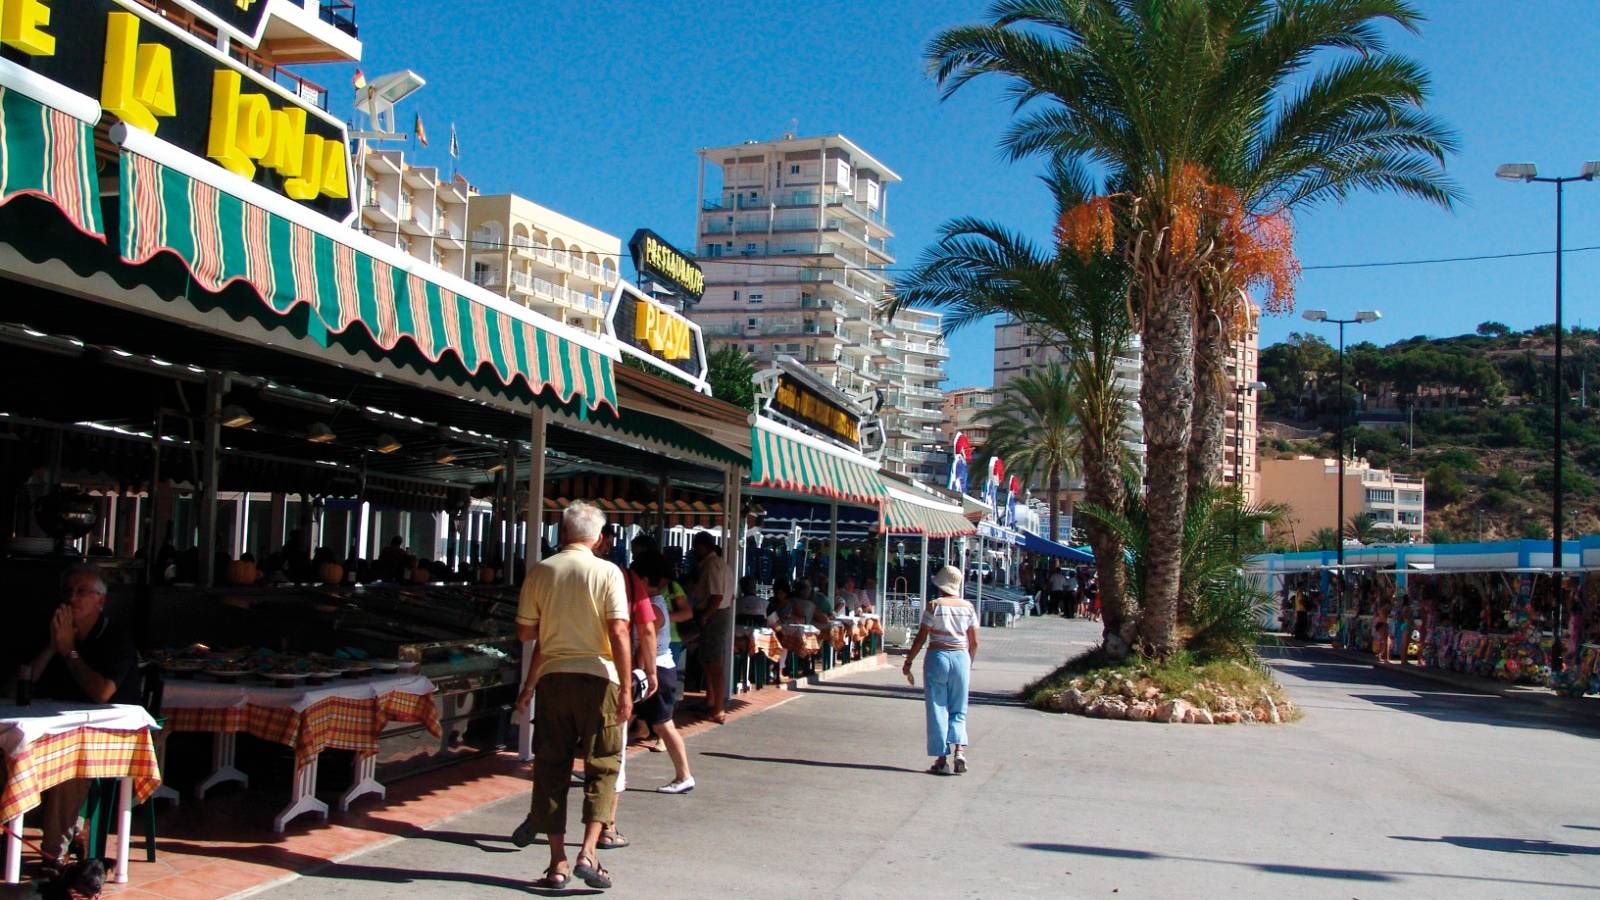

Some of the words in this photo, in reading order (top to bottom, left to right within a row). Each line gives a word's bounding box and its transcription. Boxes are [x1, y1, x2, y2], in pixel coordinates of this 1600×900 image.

[101, 12, 177, 136] LA
[207, 69, 349, 200] LONJA
[635, 302, 691, 360] PLAYA
